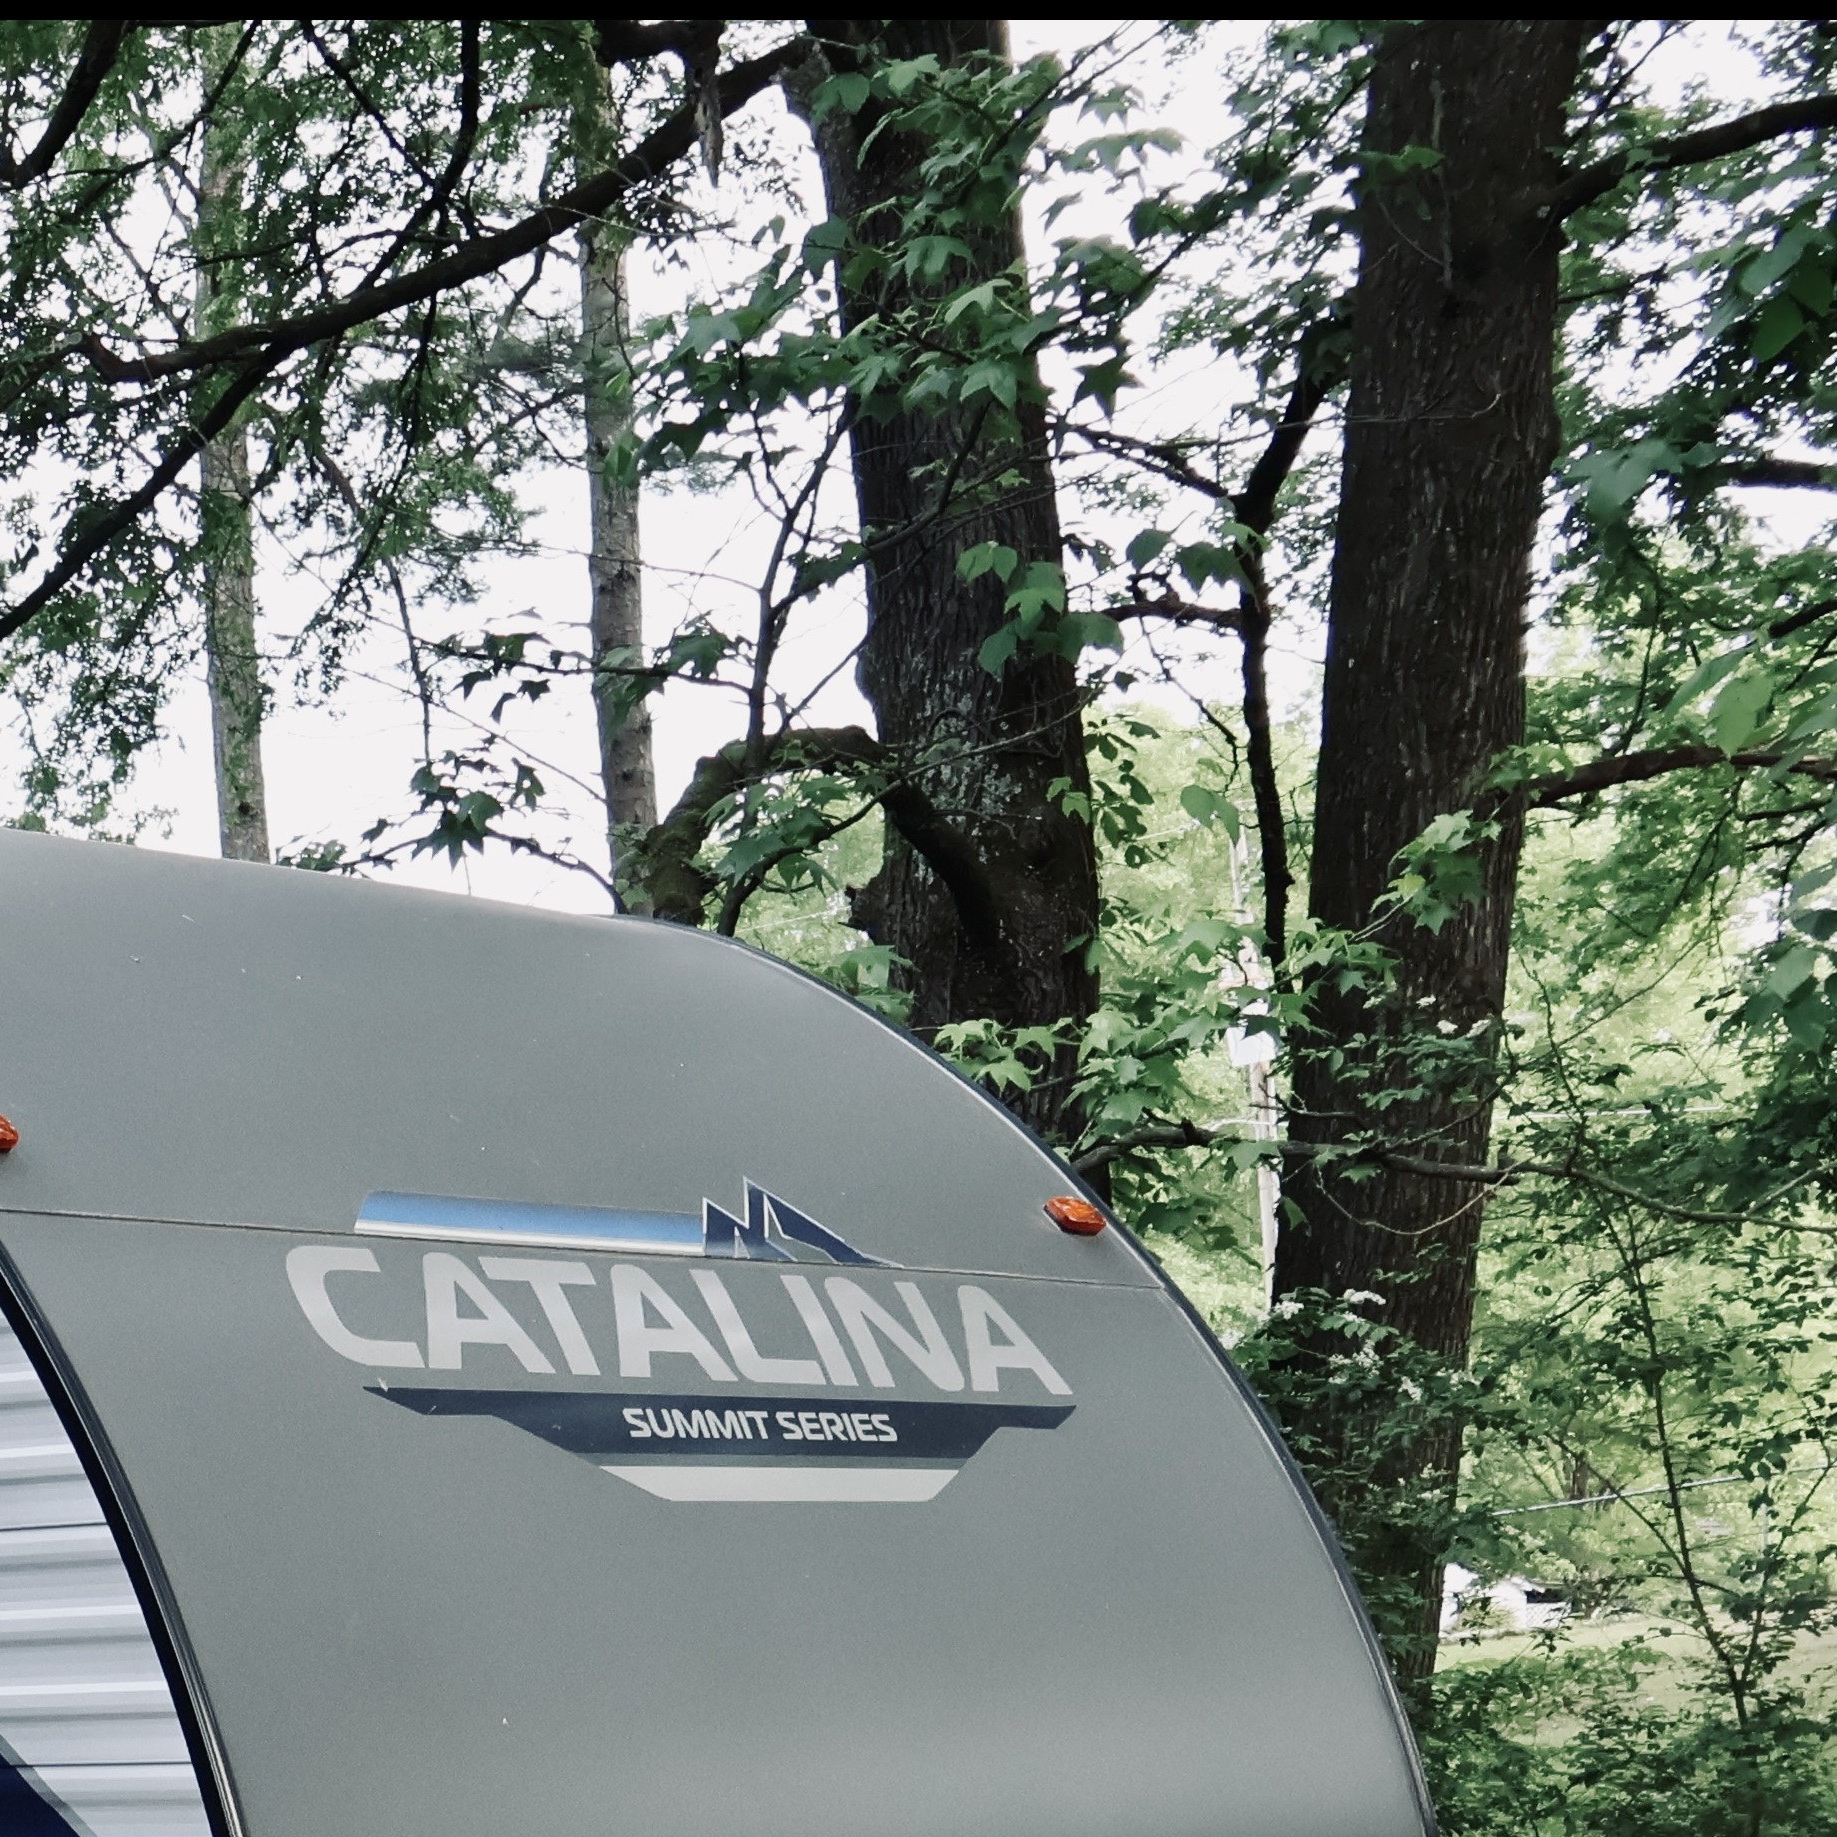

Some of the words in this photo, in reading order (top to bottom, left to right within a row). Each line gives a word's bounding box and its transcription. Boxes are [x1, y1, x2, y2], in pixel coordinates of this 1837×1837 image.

[286, 1244, 1074, 1395] CATALINA
[622, 1408, 770, 1440] SUMMIT
[777, 1411, 898, 1442] SERIES
